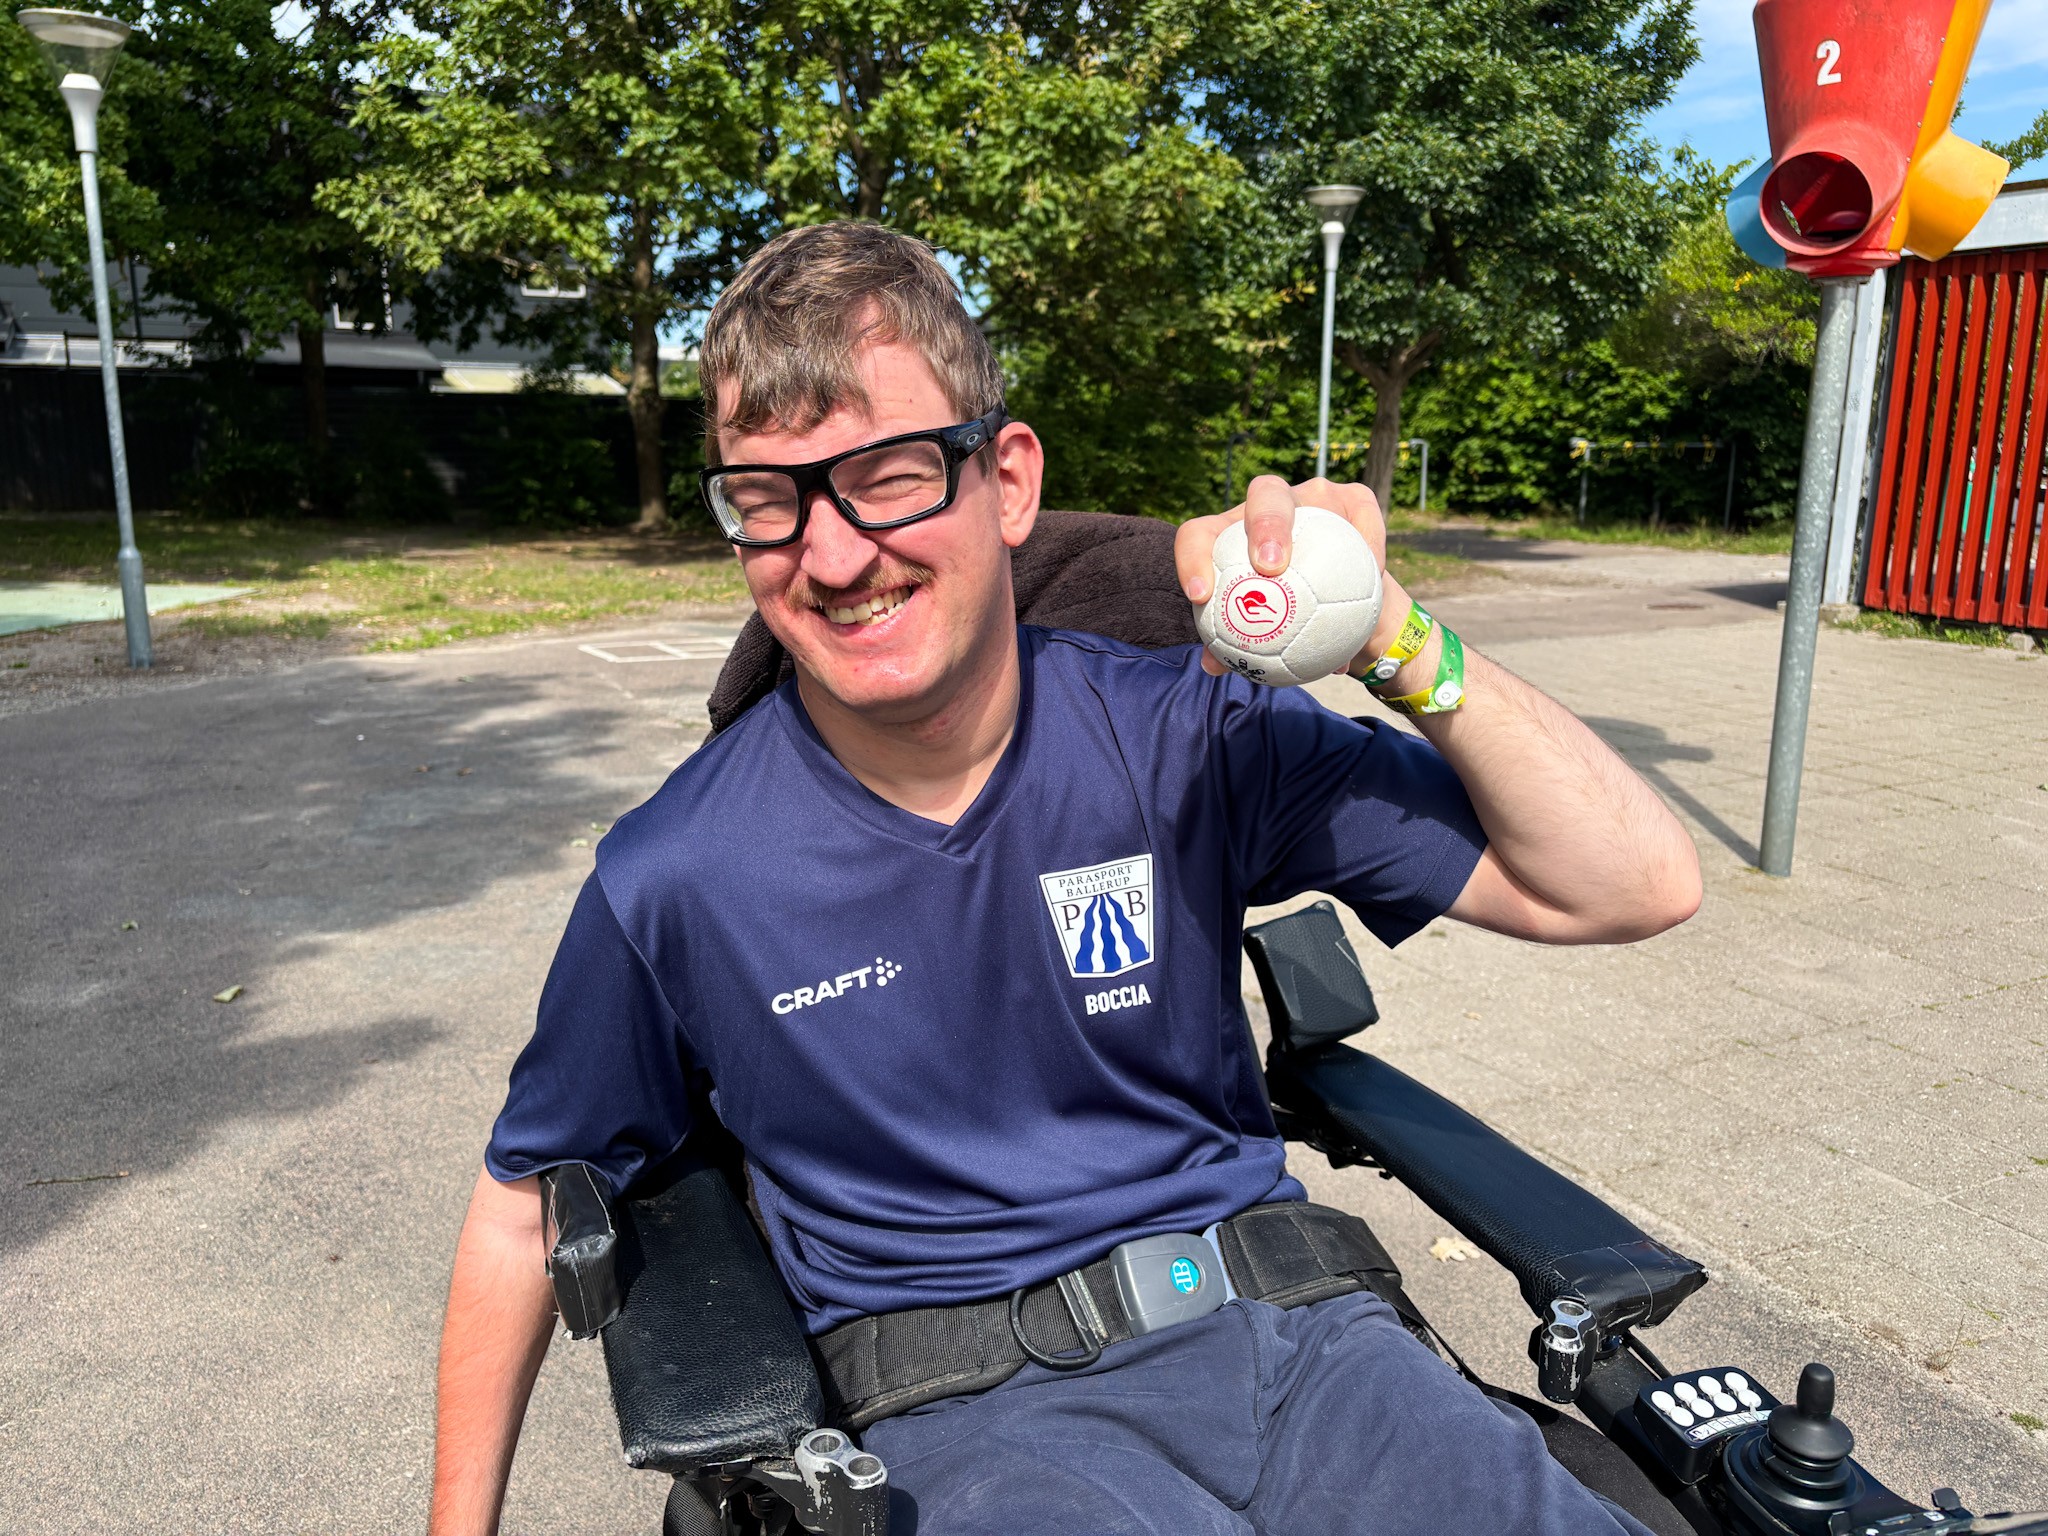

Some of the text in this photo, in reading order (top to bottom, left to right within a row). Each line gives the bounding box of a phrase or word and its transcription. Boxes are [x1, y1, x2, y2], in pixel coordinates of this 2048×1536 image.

[1816, 39, 1842, 86] 2
[1221, 574, 1244, 602] BOCCIA
[1282, 581, 1297, 624] SUPERSOFT
[1220, 611, 1236, 635] HANDI
[1236, 633, 1251, 644] LIFE
[1058, 864, 1133, 888] PARASPORT
[1066, 876, 1131, 898] BALLERUP
[1060, 889, 1147, 931] P B
[771, 966, 872, 1015] CRAFT
[1085, 983, 1152, 1016] BOCCIA
